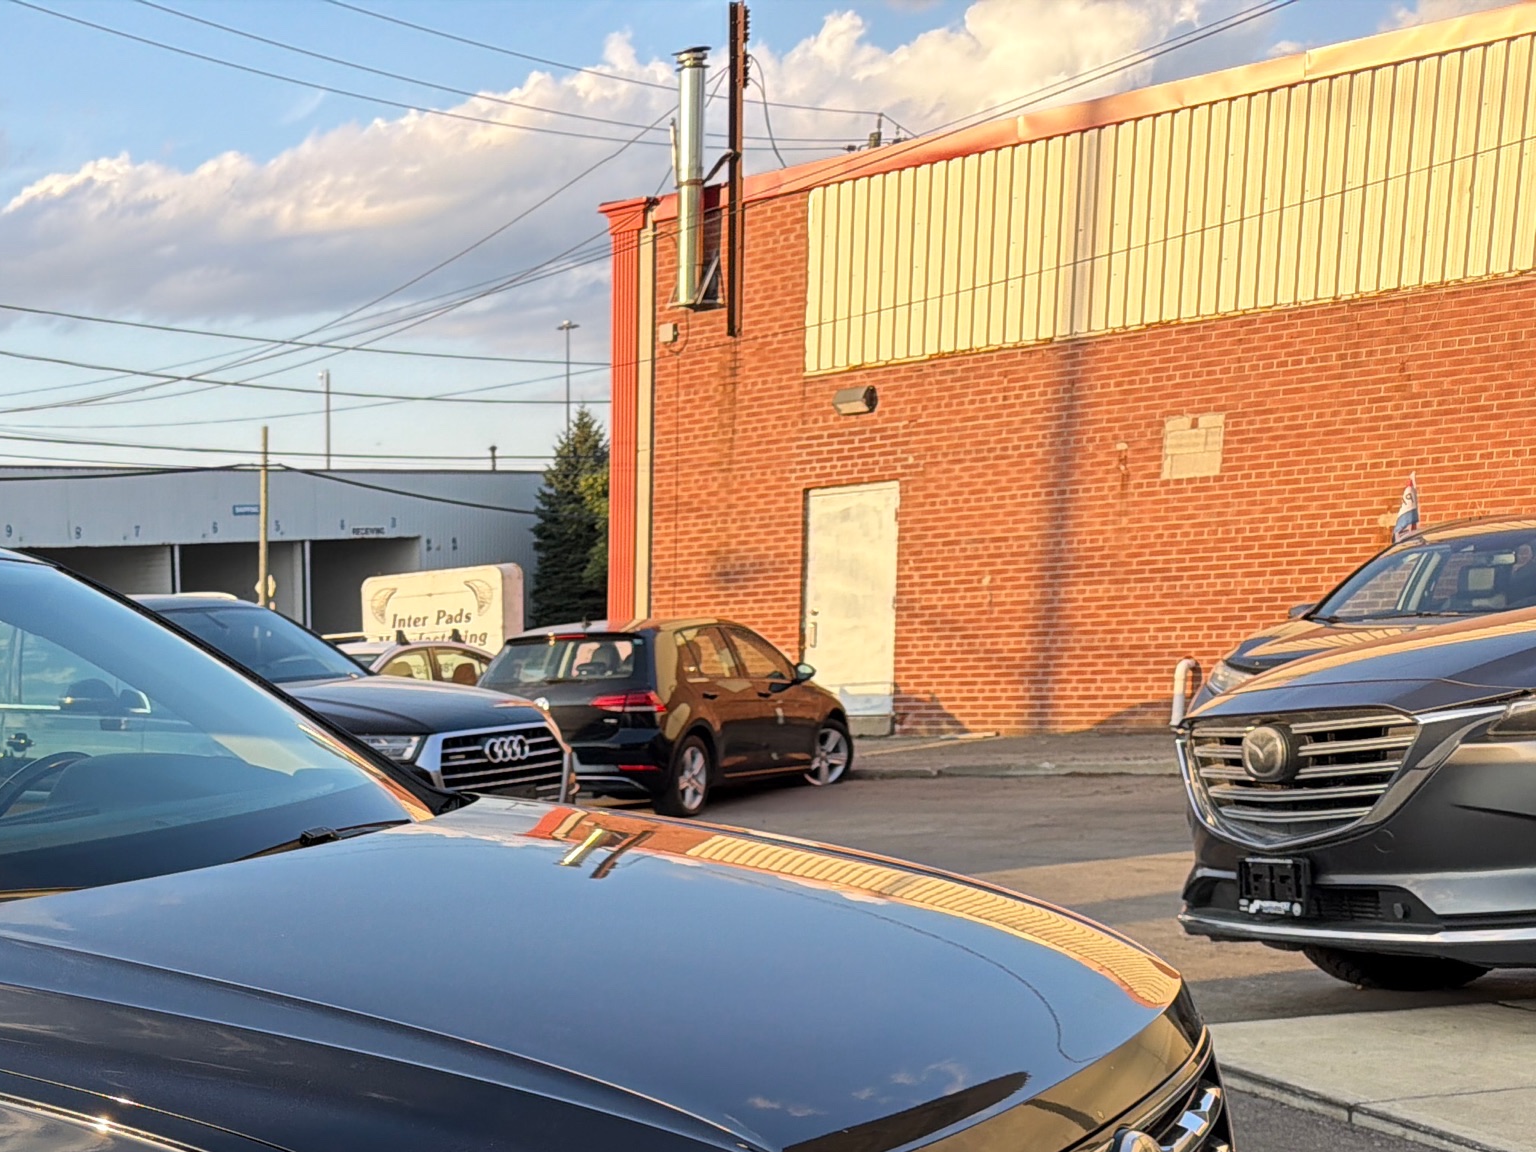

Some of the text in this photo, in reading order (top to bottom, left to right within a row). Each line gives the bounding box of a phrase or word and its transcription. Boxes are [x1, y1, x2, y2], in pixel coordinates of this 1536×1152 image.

[5, 524, 13, 538] 9
[134, 525, 141, 538] 7
[391, 608, 472, 629] Inter Pads
